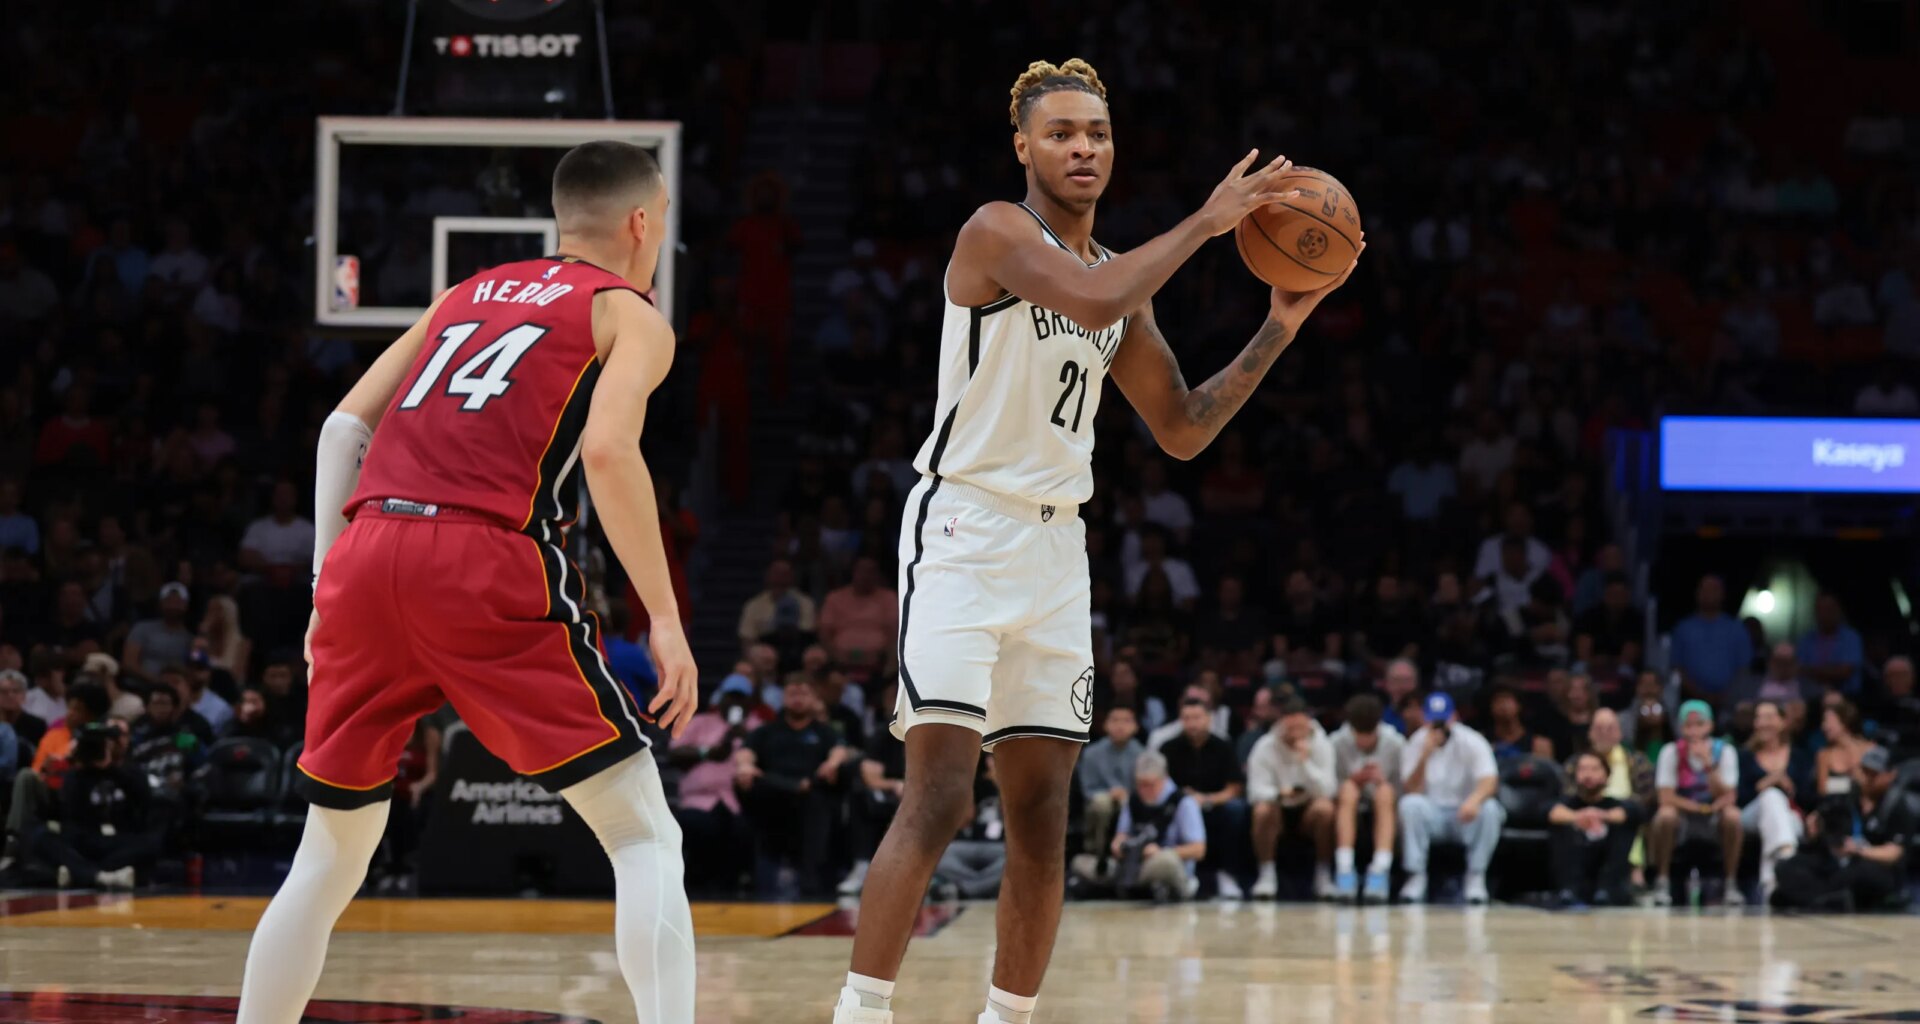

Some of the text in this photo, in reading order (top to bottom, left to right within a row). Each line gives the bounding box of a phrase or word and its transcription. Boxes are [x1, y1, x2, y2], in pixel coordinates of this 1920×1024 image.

[473, 34, 581, 57] TISSOT
[397, 320, 552, 412] 14
[1050, 359, 1088, 433] 21
[1812, 438, 1905, 473] Kaseya
[471, 802, 563, 825] Airlines
